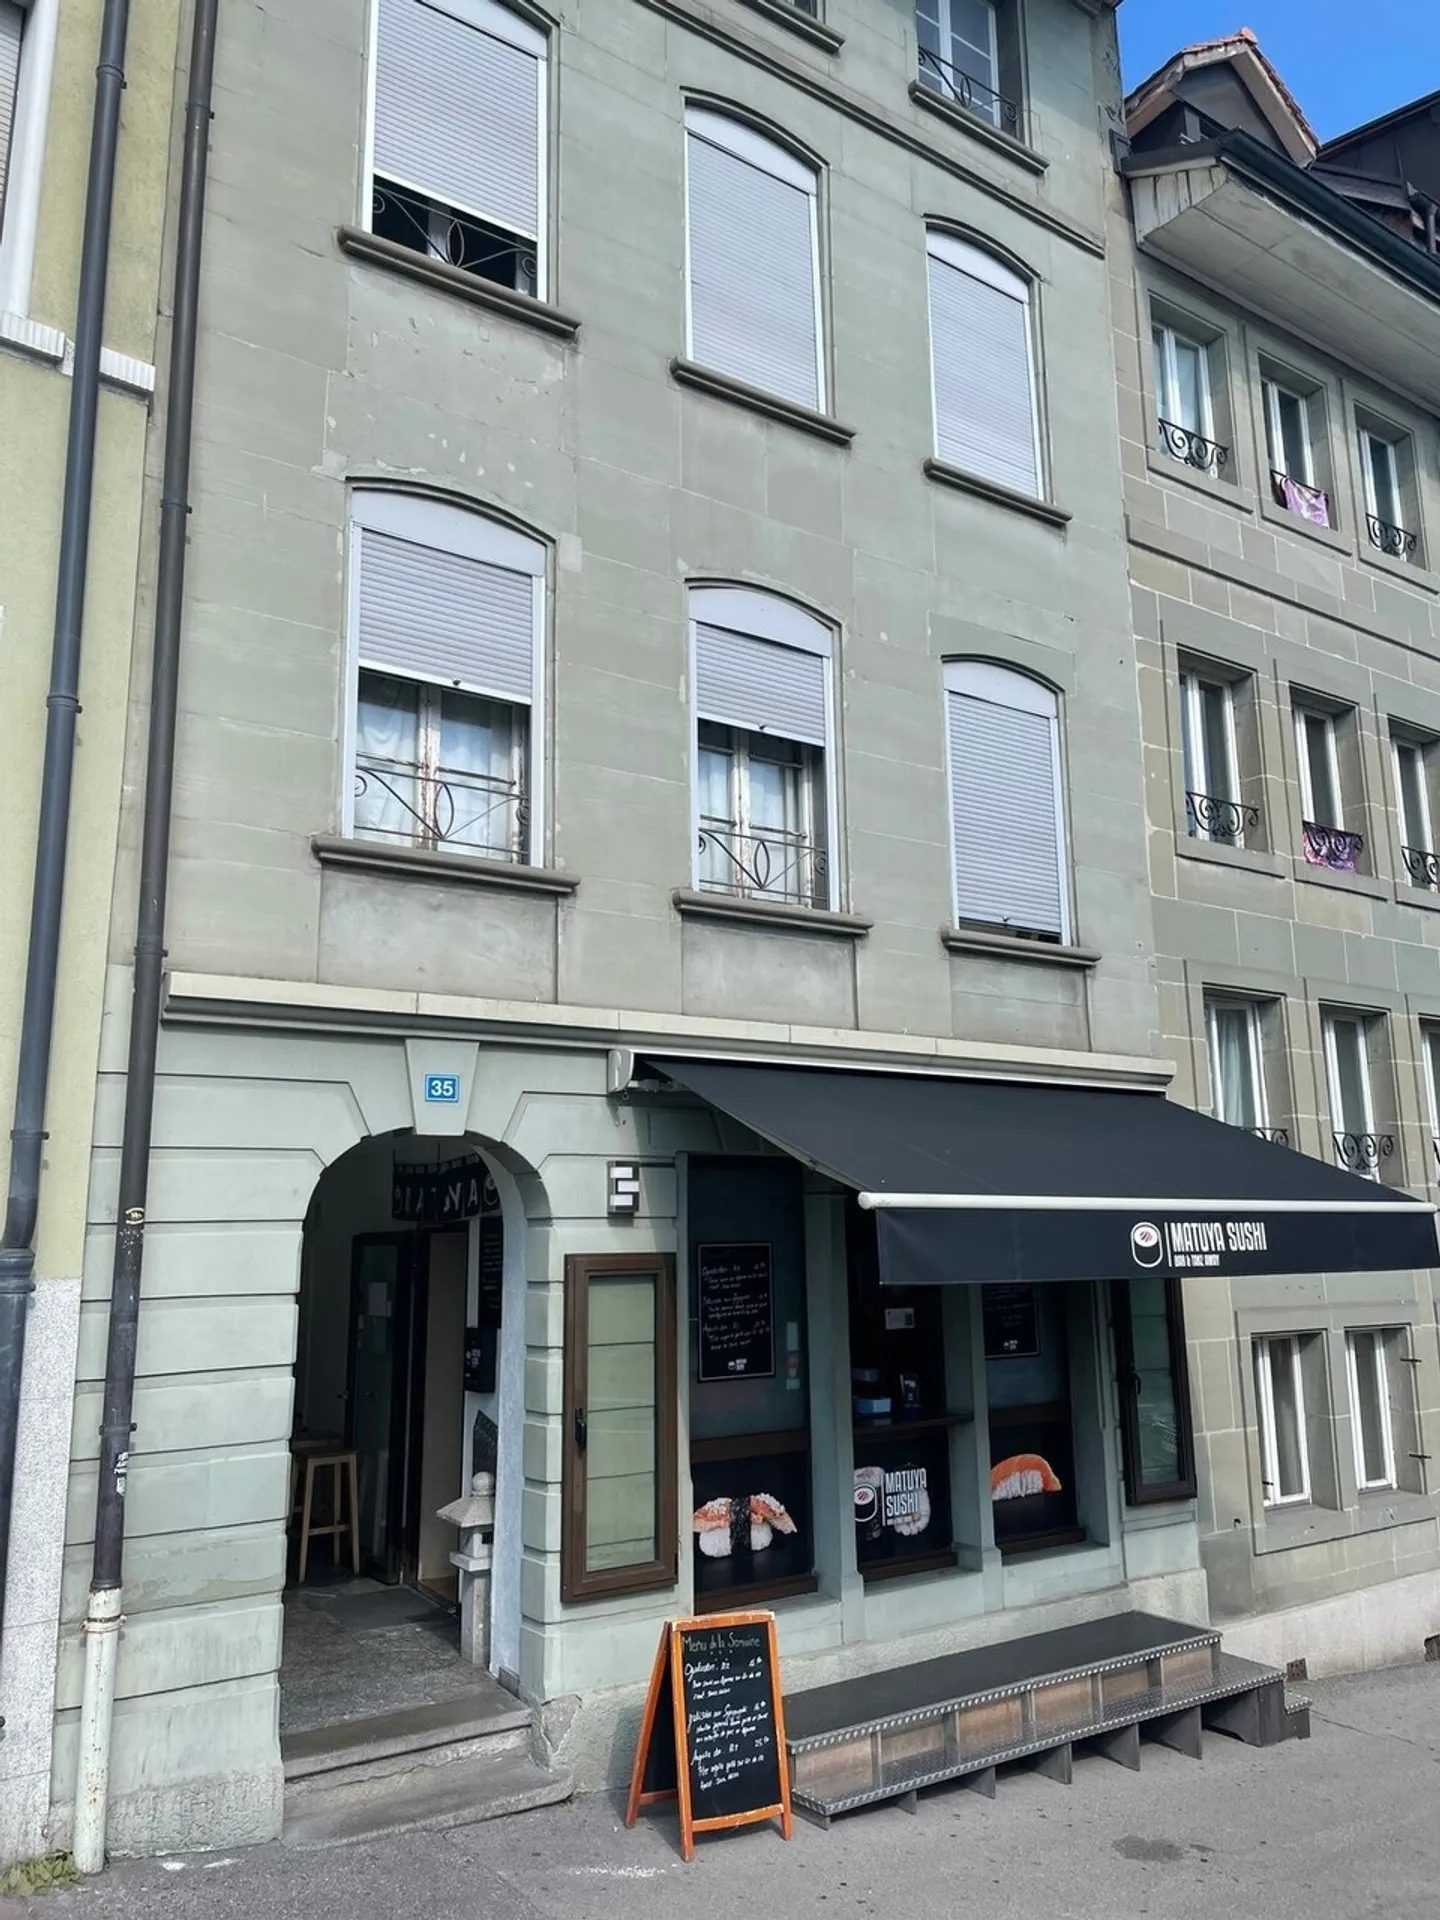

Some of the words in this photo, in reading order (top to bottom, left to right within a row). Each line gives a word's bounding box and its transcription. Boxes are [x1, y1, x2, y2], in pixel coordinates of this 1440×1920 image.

[431, 1079, 453, 1096] 35
[1170, 1222, 1225, 1252] MATUYA
[1226, 1222, 1267, 1251] SUSHI
[885, 1468, 927, 1494] MATUYA
[886, 1491, 919, 1517] SUSHI
[682, 1636, 707, 1652] Menu
